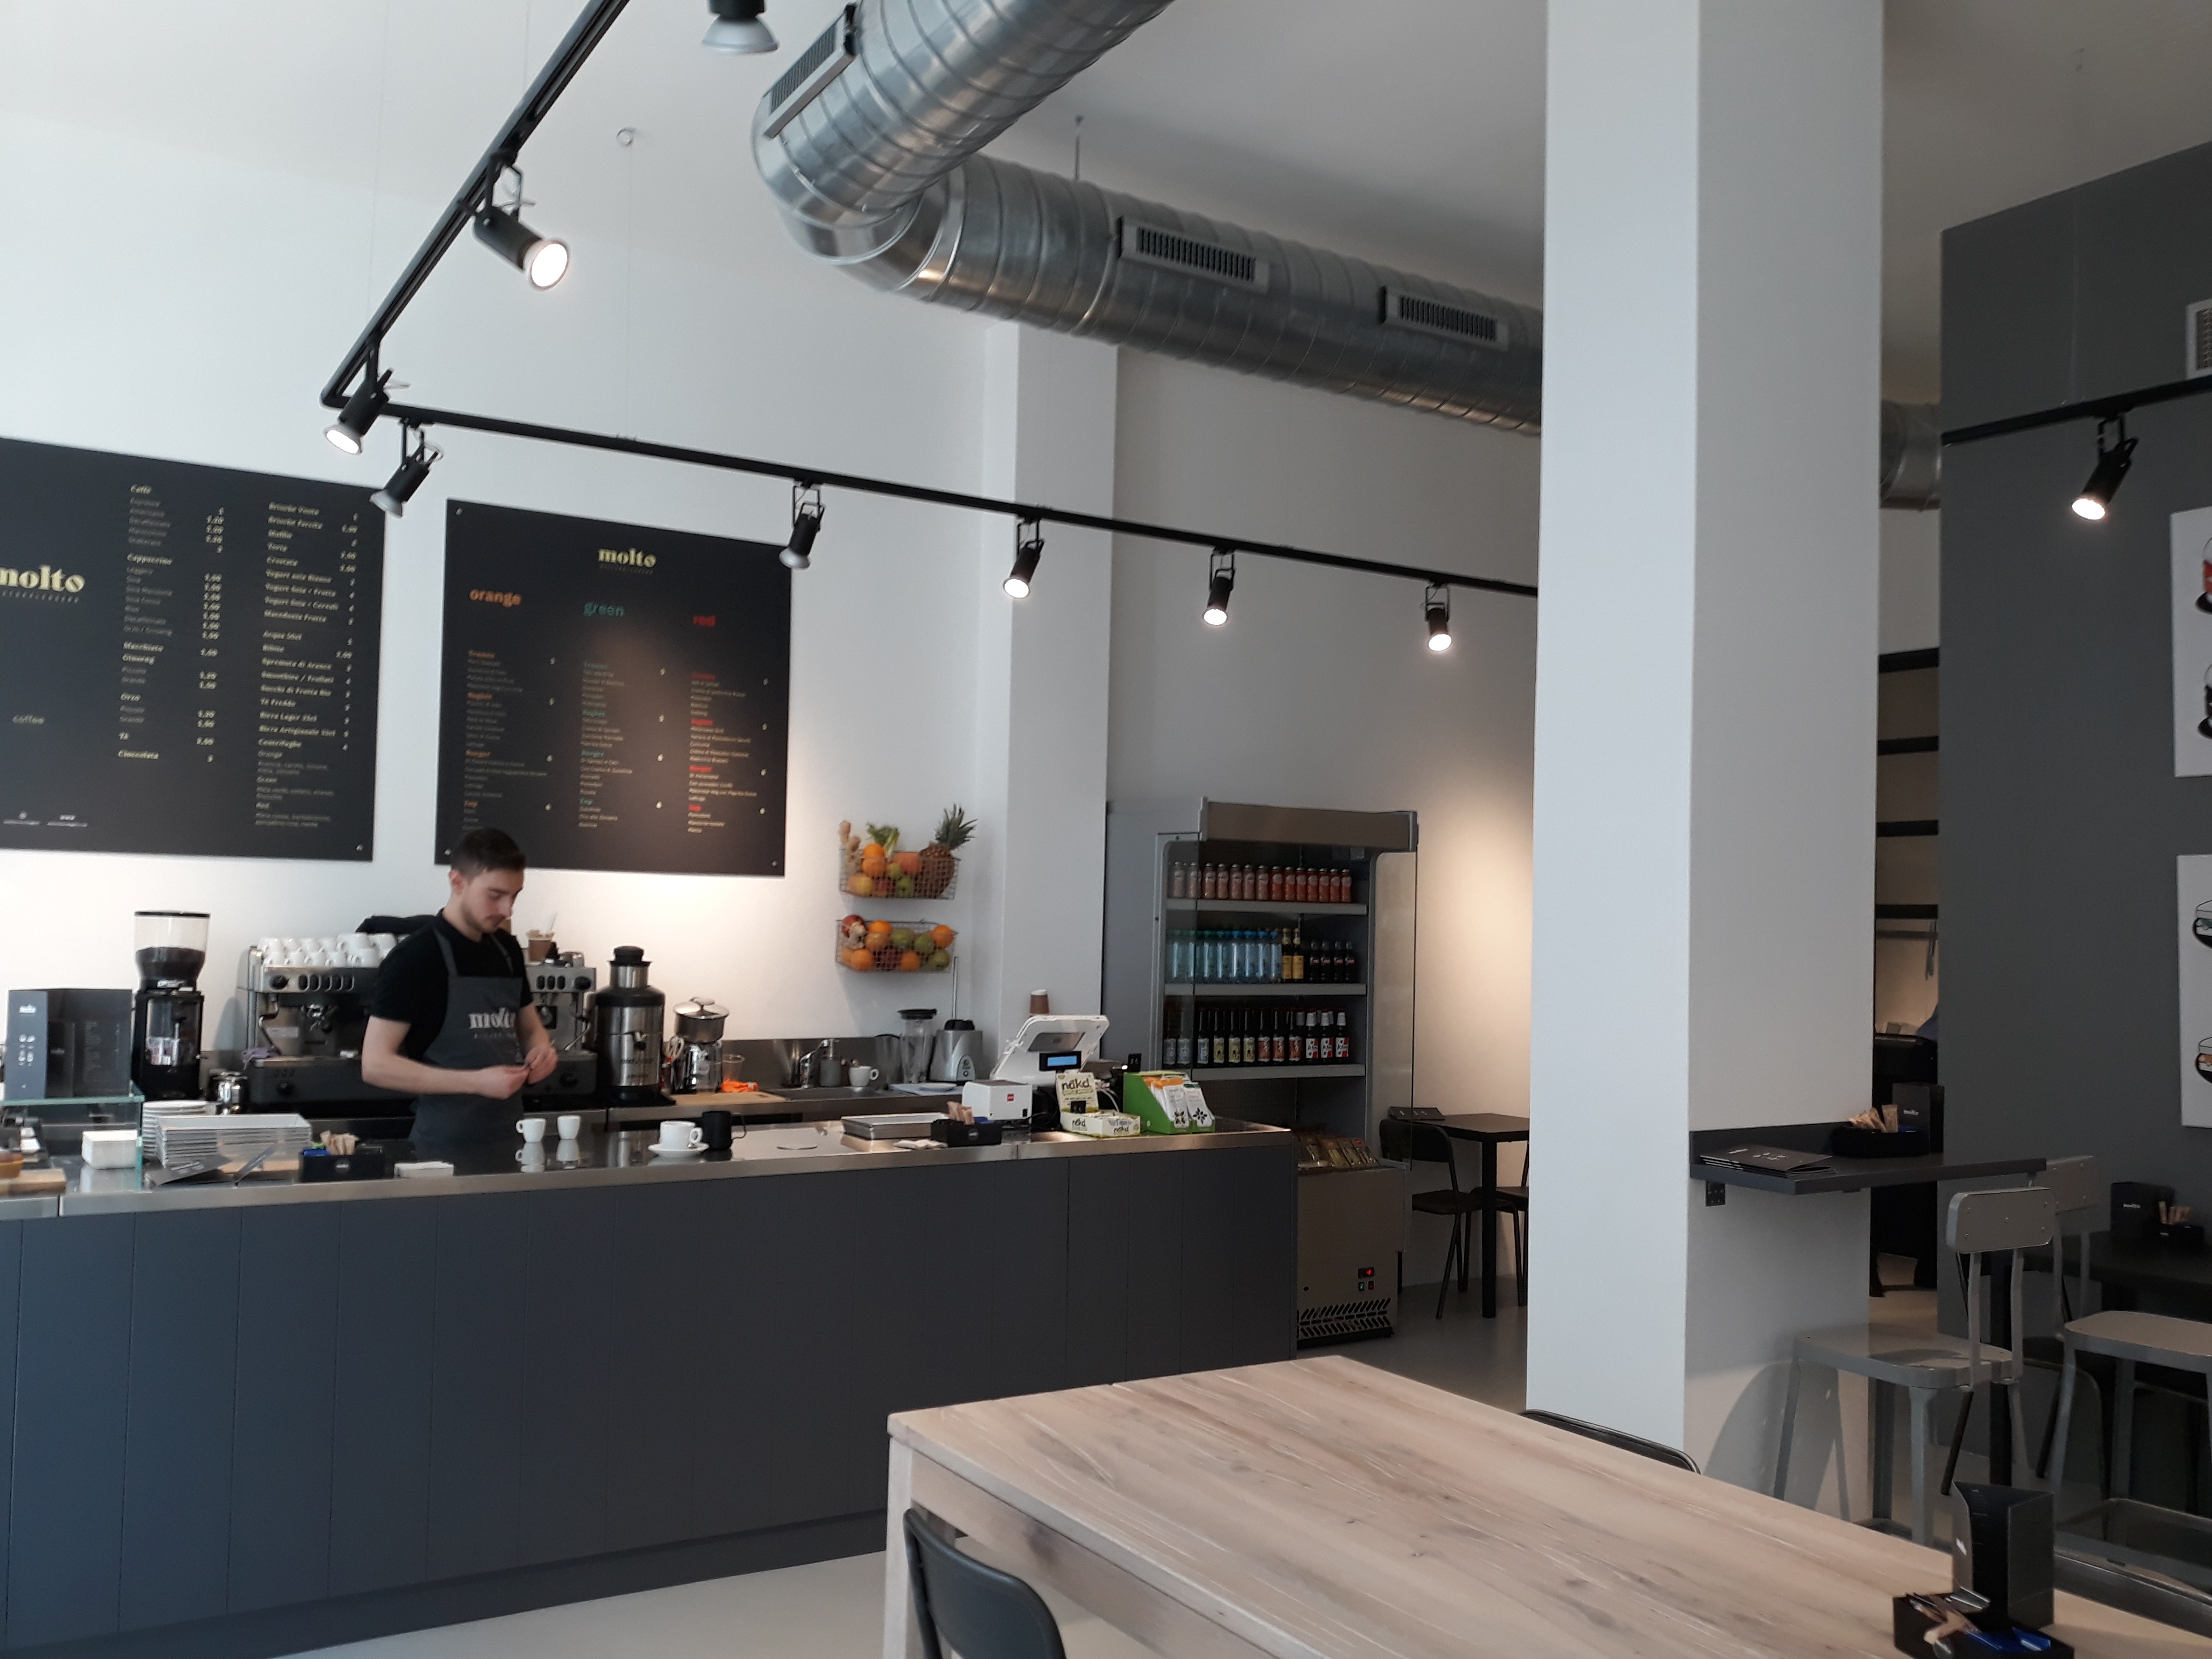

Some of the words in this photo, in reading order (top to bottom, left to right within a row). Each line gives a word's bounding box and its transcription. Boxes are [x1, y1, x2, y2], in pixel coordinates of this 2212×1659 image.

[597, 548, 657, 568] molto
[469, 589, 522, 608] orange
[584, 601, 625, 616] green
